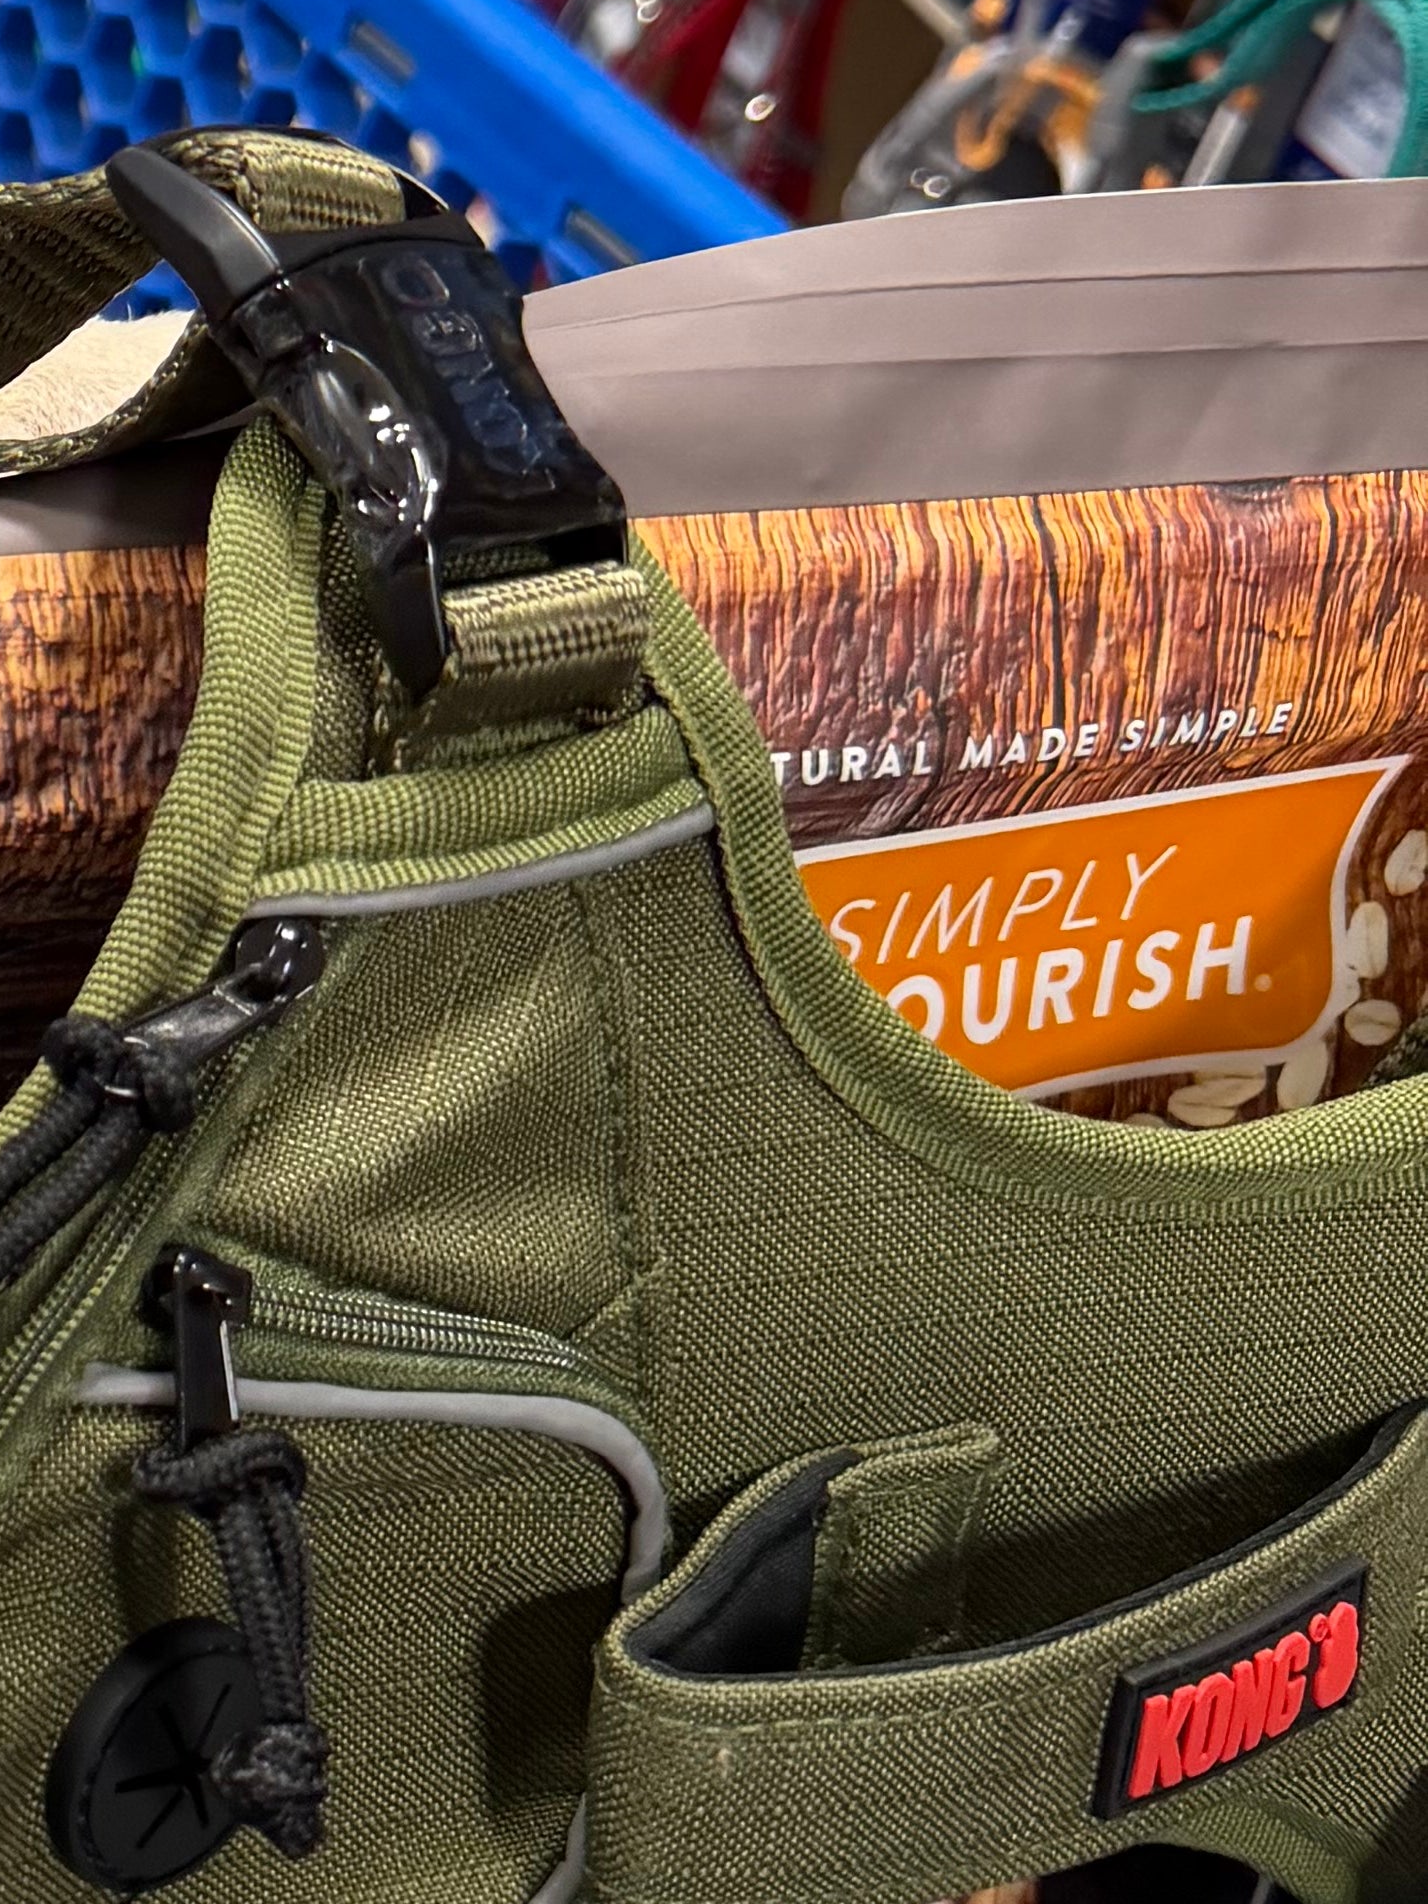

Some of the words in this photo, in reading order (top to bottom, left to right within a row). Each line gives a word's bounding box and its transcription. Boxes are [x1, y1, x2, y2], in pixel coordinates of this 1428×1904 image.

[770, 740, 932, 786] TURAL
[960, 723, 1099, 772] MADE
[1119, 702, 1294, 752] SIMPLE
[830, 844, 1178, 966] SIMPLY
[885, 916, 1253, 1044] OURISH
[1128, 1631, 1310, 1799] KONG
